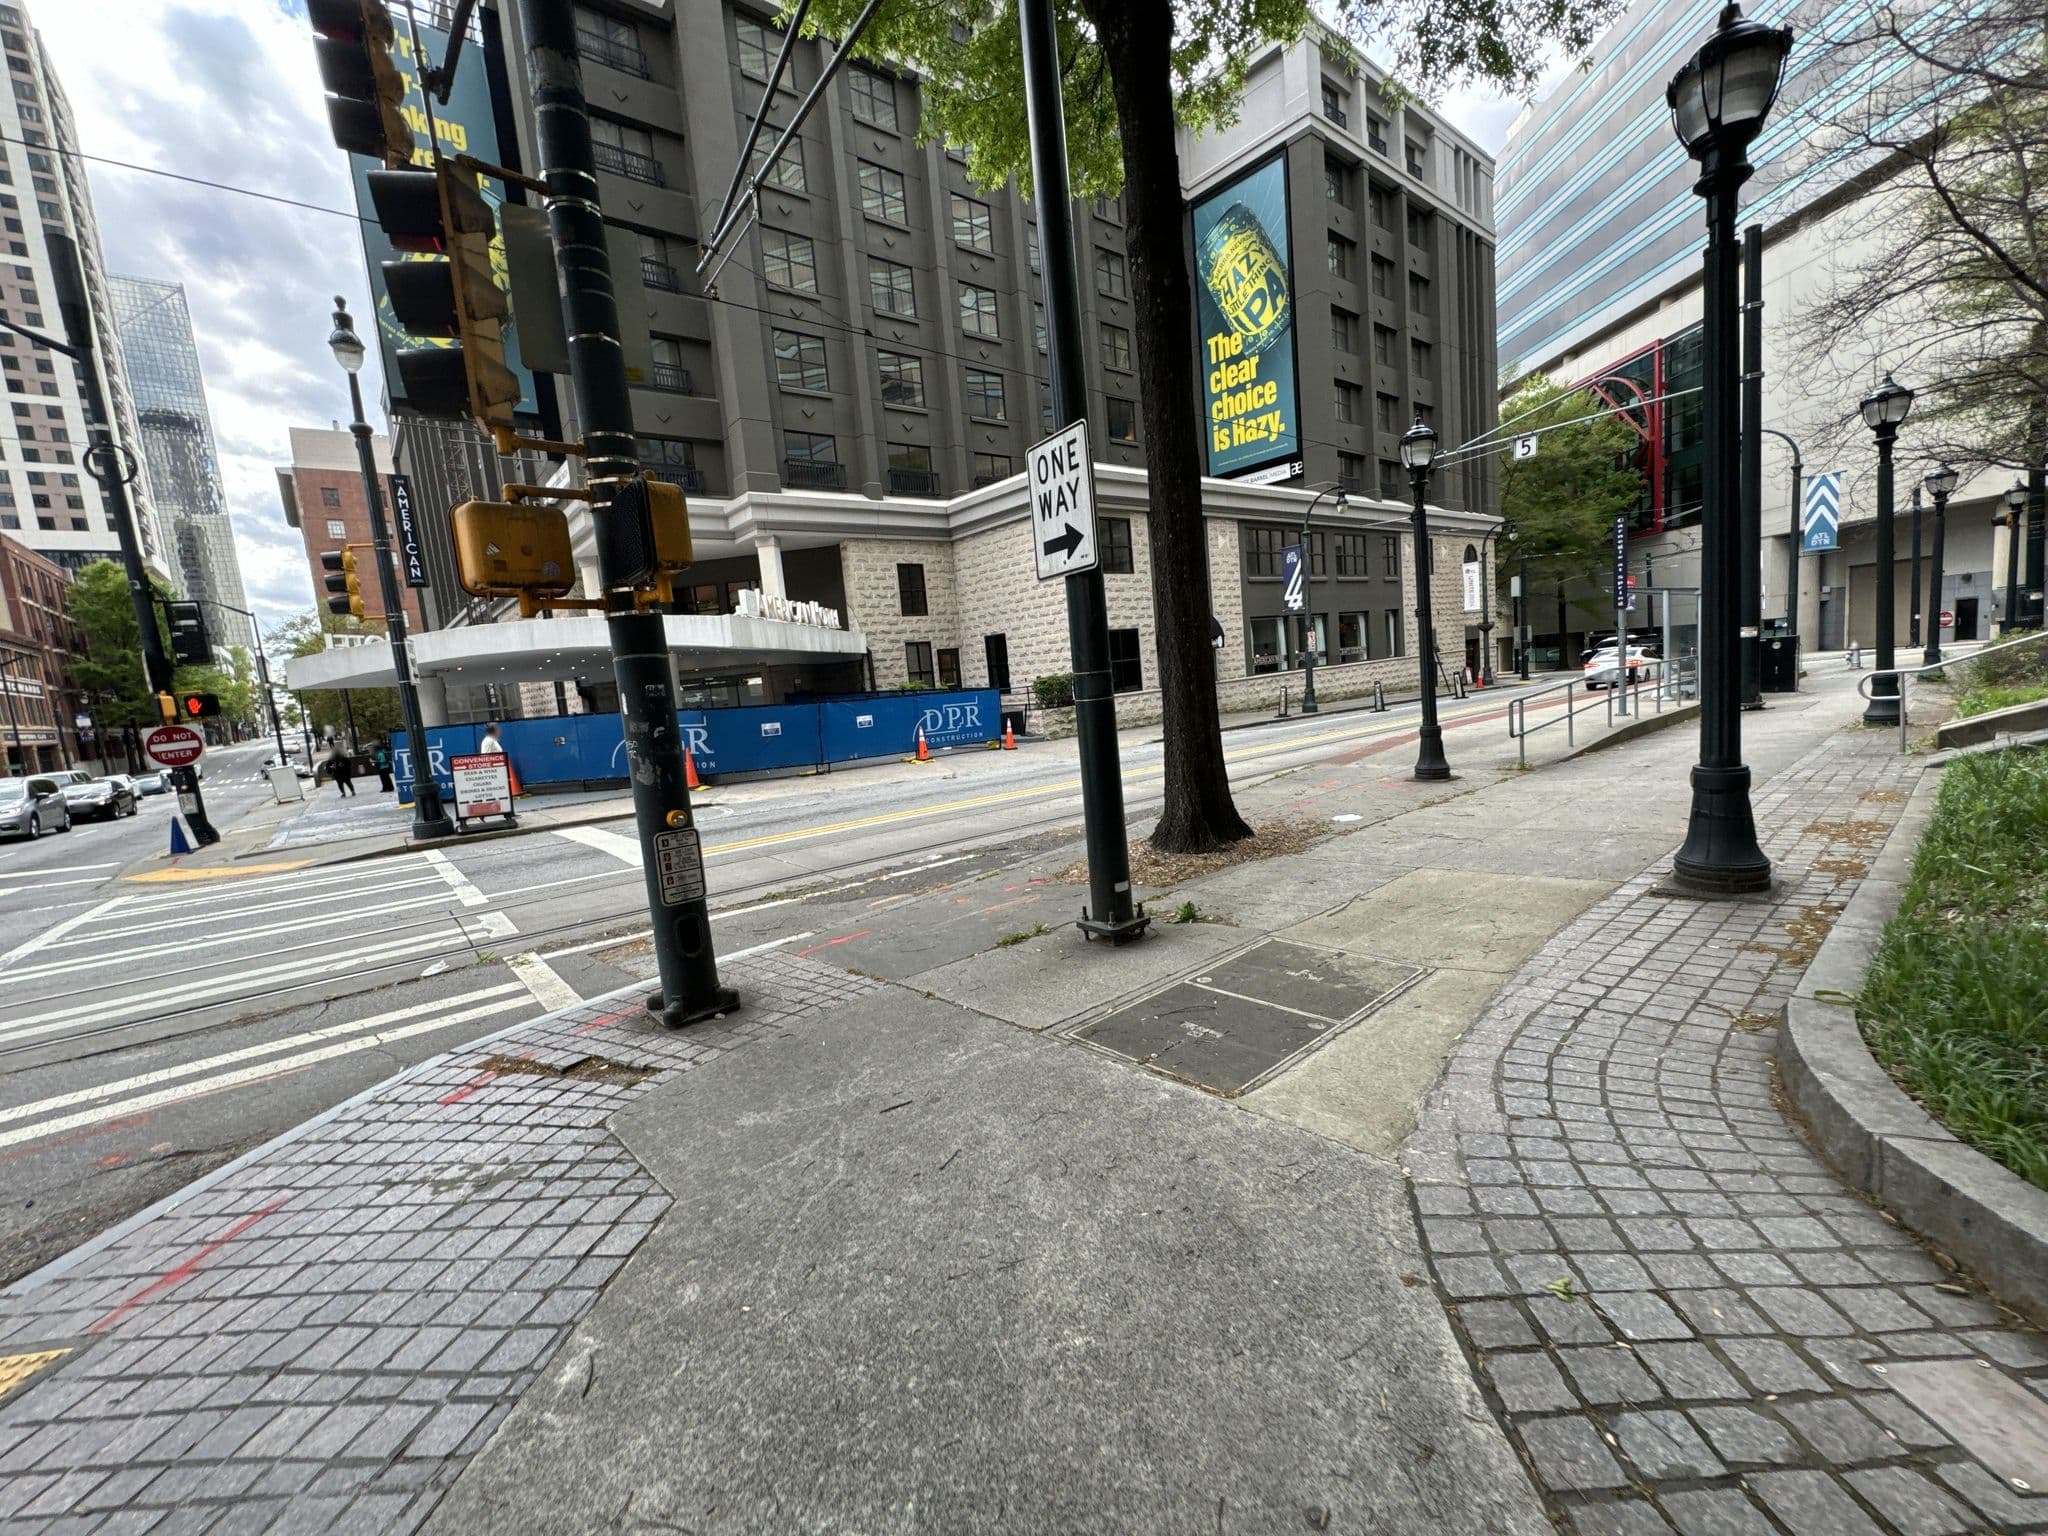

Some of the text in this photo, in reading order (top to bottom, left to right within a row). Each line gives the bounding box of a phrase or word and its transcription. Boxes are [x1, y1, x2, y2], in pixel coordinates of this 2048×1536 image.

[1221, 246, 1265, 305] HAZY
[1247, 258, 1273, 289] THING
[1231, 267, 1286, 334] IPA
[1207, 331, 1243, 364] The
[1210, 354, 1260, 394] clear
[1212, 380, 1277, 423] choice
[1213, 410, 1286, 453] is Hazy.
[1521, 438, 1531, 456] 5
[1037, 438, 1080, 485] ONE
[1039, 477, 1080, 522] WAY
[397, 486, 421, 578] AMERICAN
[923, 705, 983, 732] DPR
[153, 732, 192, 743] DO NOT
[161, 749, 193, 760] ENTER
[926, 732, 983, 744] CONSTRUCTION
[453, 755, 505, 765] CONVENIENCE
